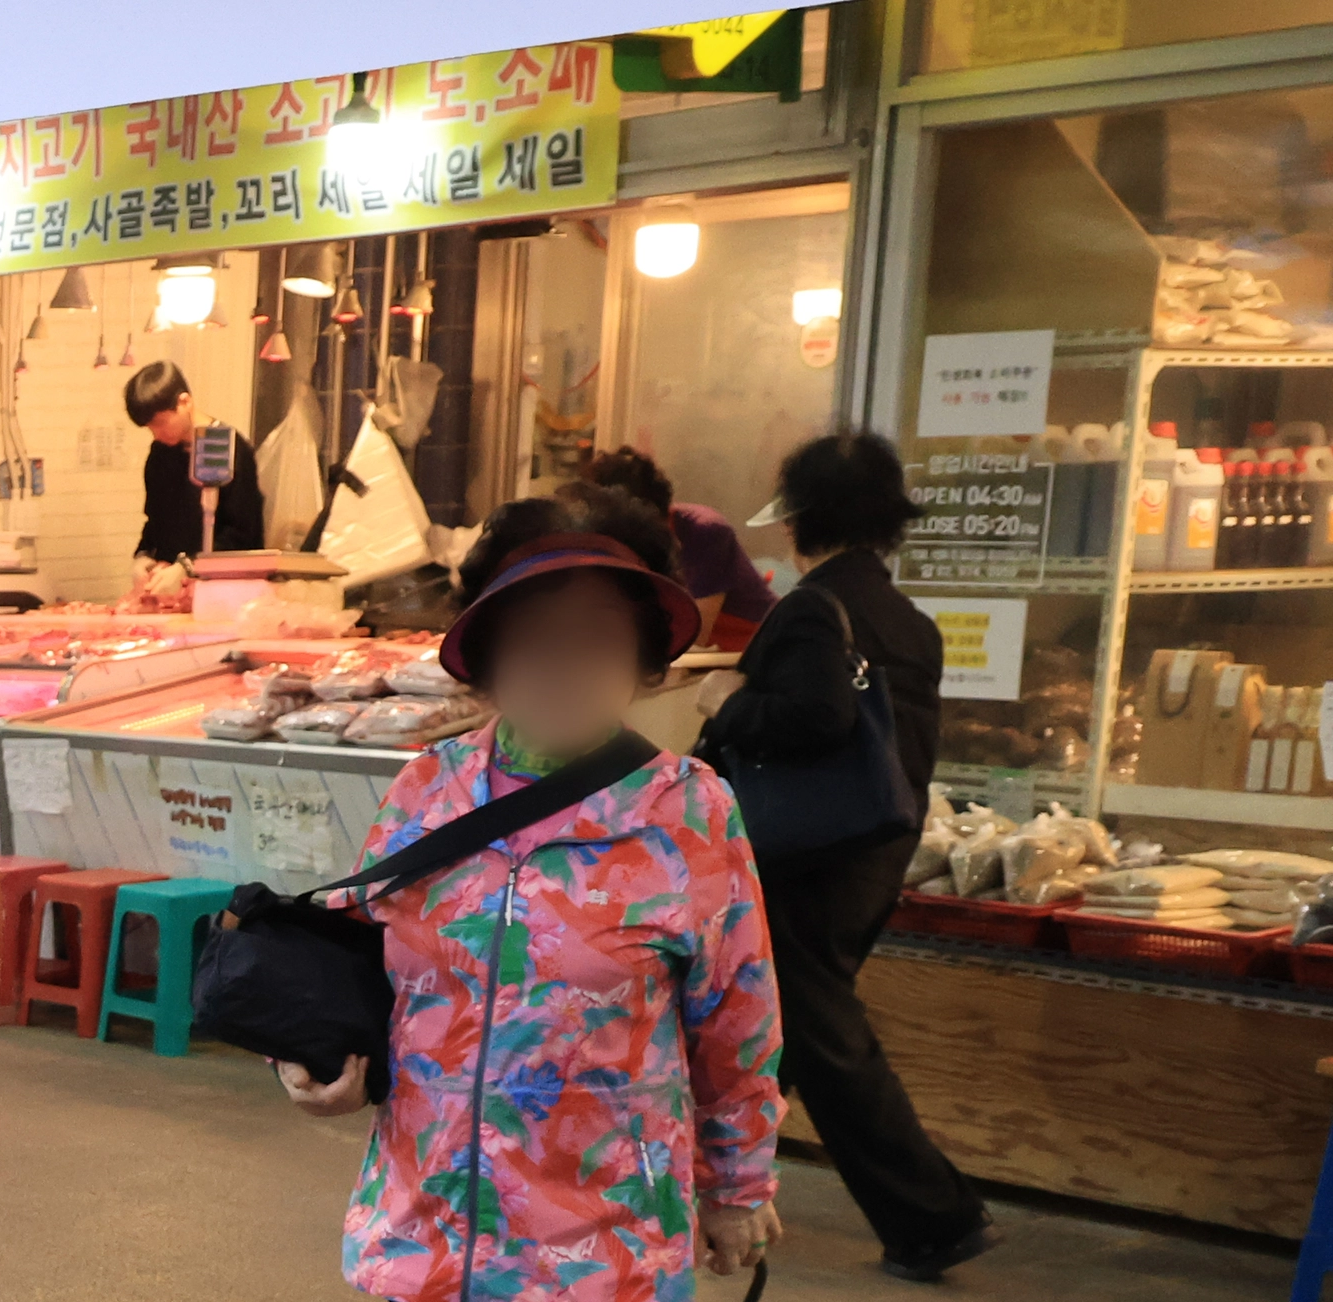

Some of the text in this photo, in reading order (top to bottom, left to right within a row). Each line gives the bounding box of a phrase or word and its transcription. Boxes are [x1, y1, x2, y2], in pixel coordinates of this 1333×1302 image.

[126, 88, 244, 169] 국내산
[404, 144, 482, 204] 세일
[498, 127, 585, 192] 세일
[909, 486, 963, 505] OPEN
